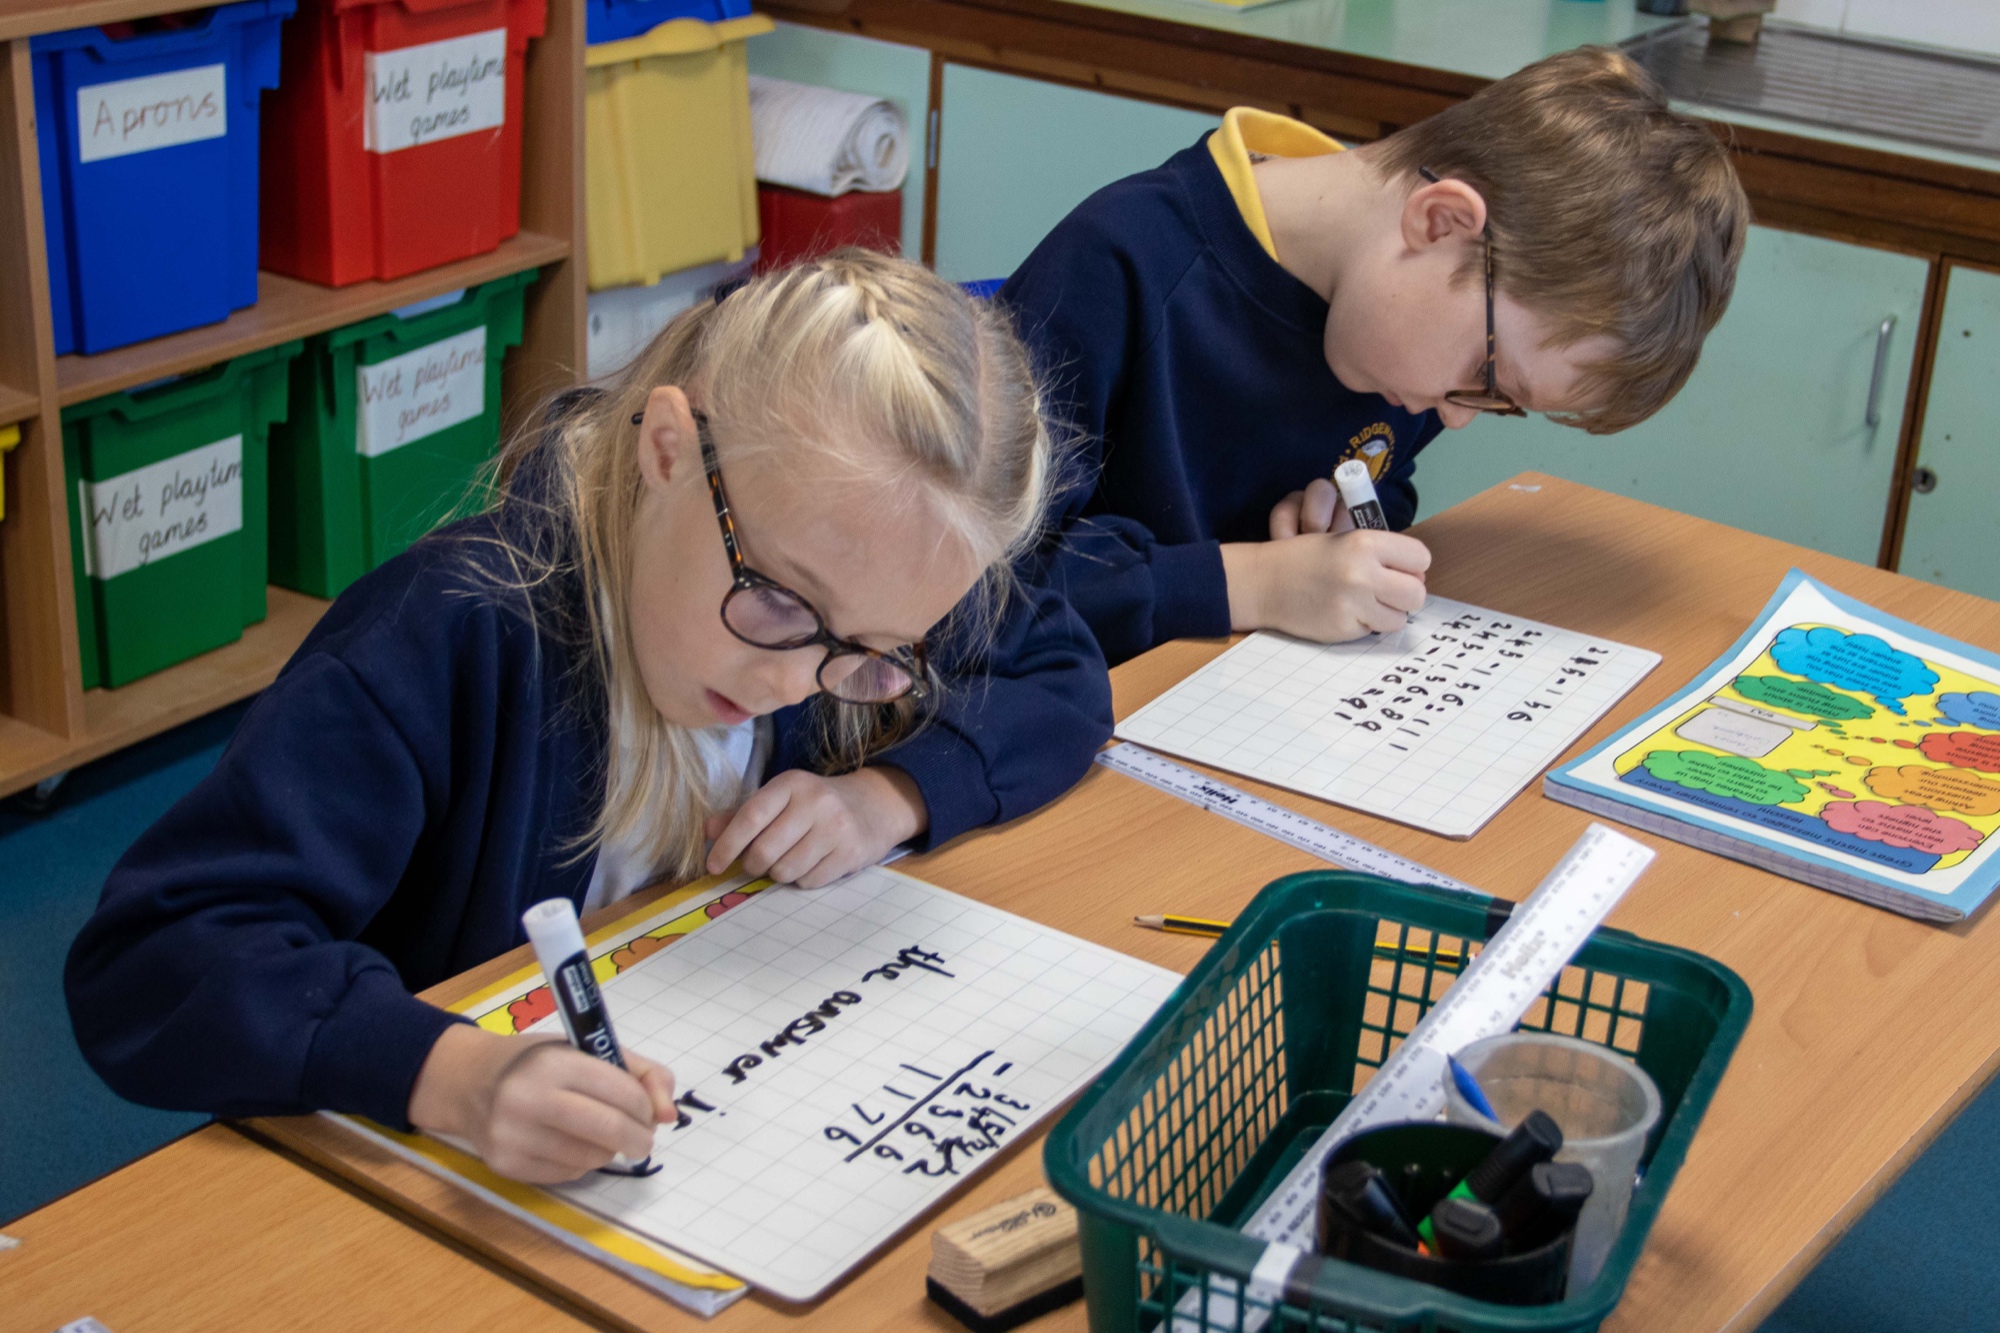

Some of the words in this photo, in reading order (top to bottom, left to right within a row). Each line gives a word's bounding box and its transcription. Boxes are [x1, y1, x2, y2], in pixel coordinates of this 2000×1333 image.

[372, 67, 411, 105] Wet
[93, 91, 218, 141] Aprons
[410, 105, 470, 145] games
[362, 366, 402, 405] Wet
[396, 393, 450, 442] games
[92, 483, 143, 527] Wet
[138, 512, 207, 567] games
[1823, 837, 1867, 853] maths
[1868, 851, 1913, 867] Great
[862, 945, 955, 982] the
[721, 990, 862, 1085] answer
[824, 1063, 943, 1145] 1176
